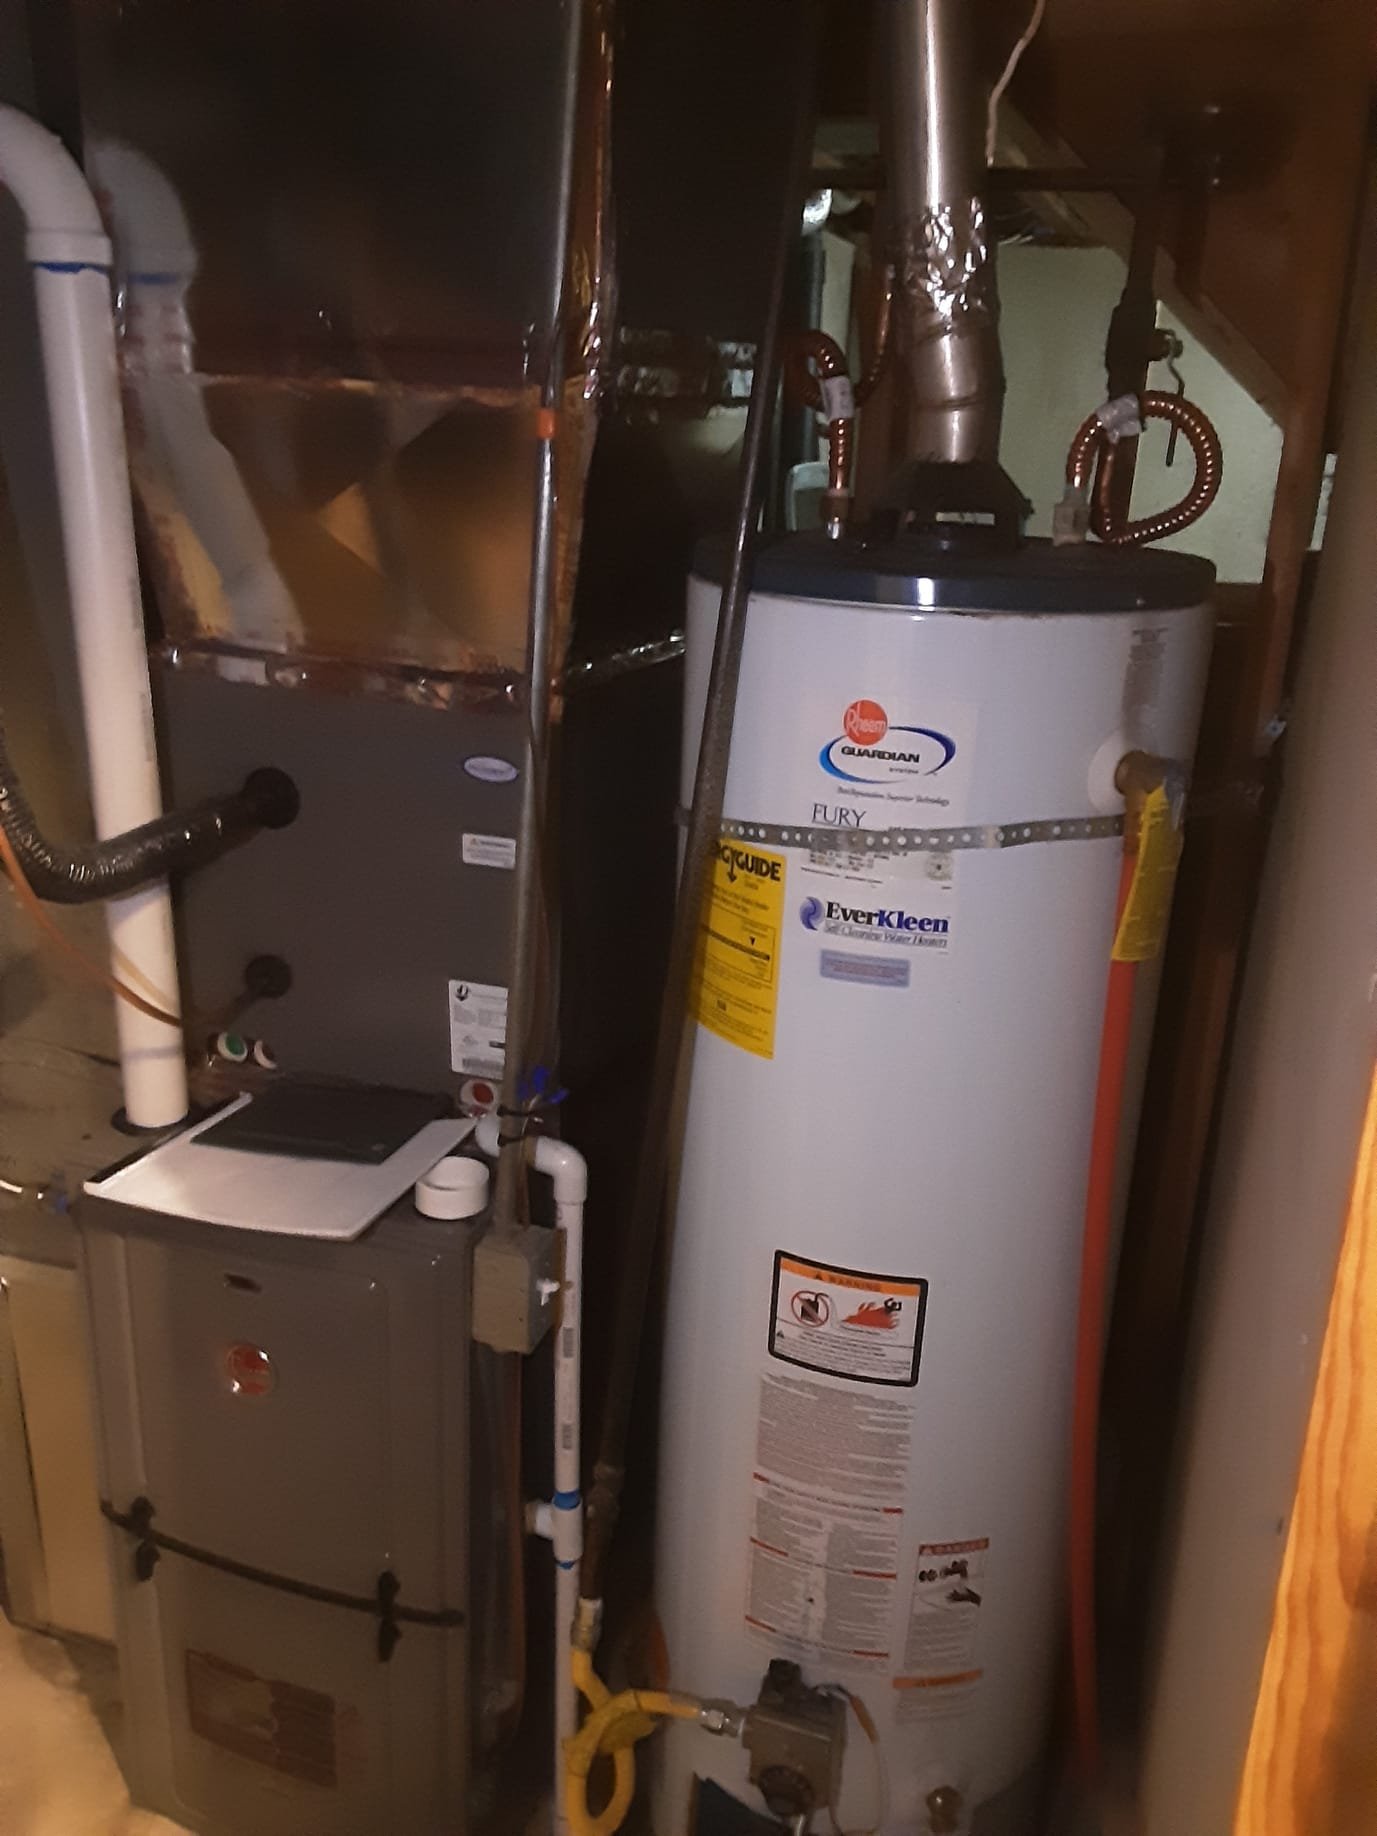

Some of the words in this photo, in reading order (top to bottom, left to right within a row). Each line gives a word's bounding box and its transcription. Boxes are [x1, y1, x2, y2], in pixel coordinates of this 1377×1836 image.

[846, 703, 886, 737] Rheem
[841, 746, 920, 763] GUARDIAN
[812, 803, 866, 828] FURY
[826, 901, 949, 933] EverKleen
